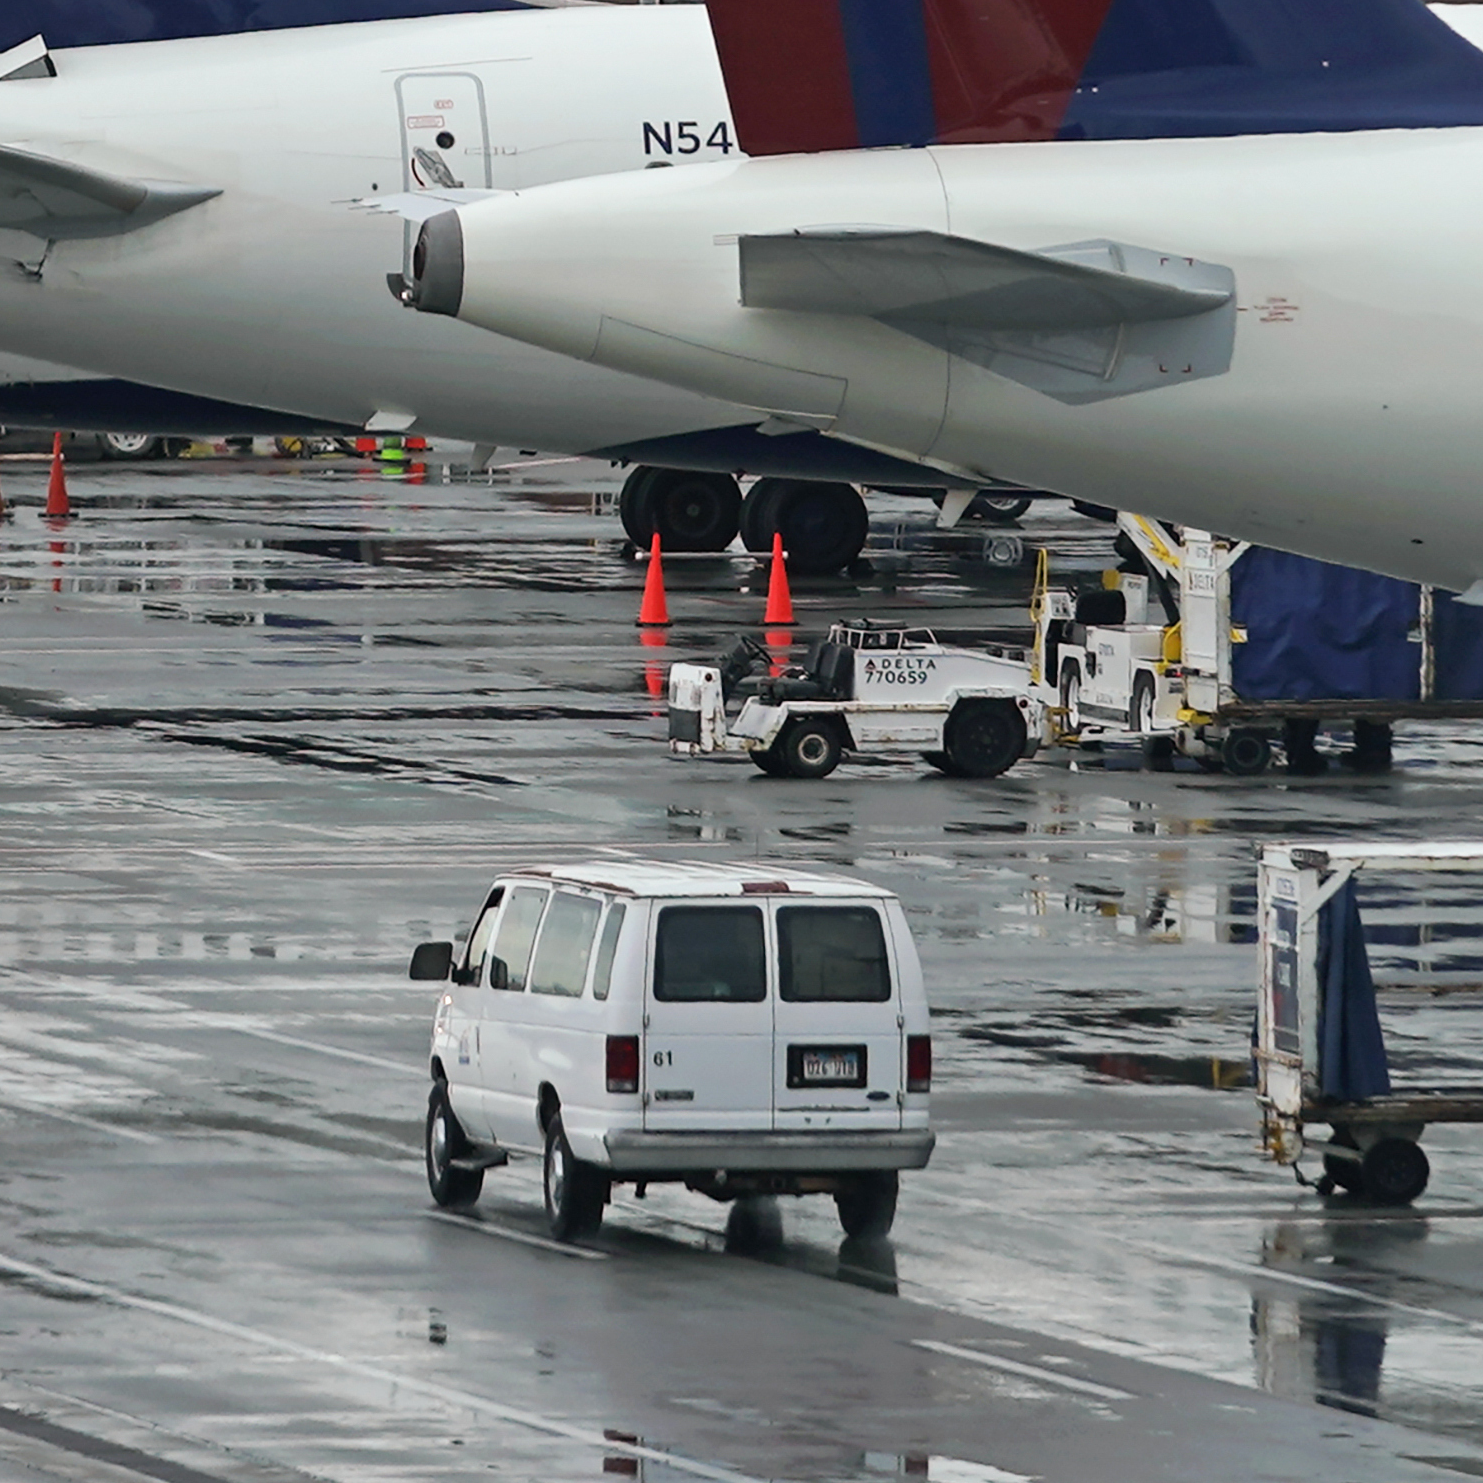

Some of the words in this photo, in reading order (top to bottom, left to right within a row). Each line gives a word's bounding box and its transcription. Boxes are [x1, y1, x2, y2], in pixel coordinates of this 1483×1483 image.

[881, 658, 936, 670] DELTA
[865, 670, 928, 685] 770659
[653, 1050, 673, 1067] 61
